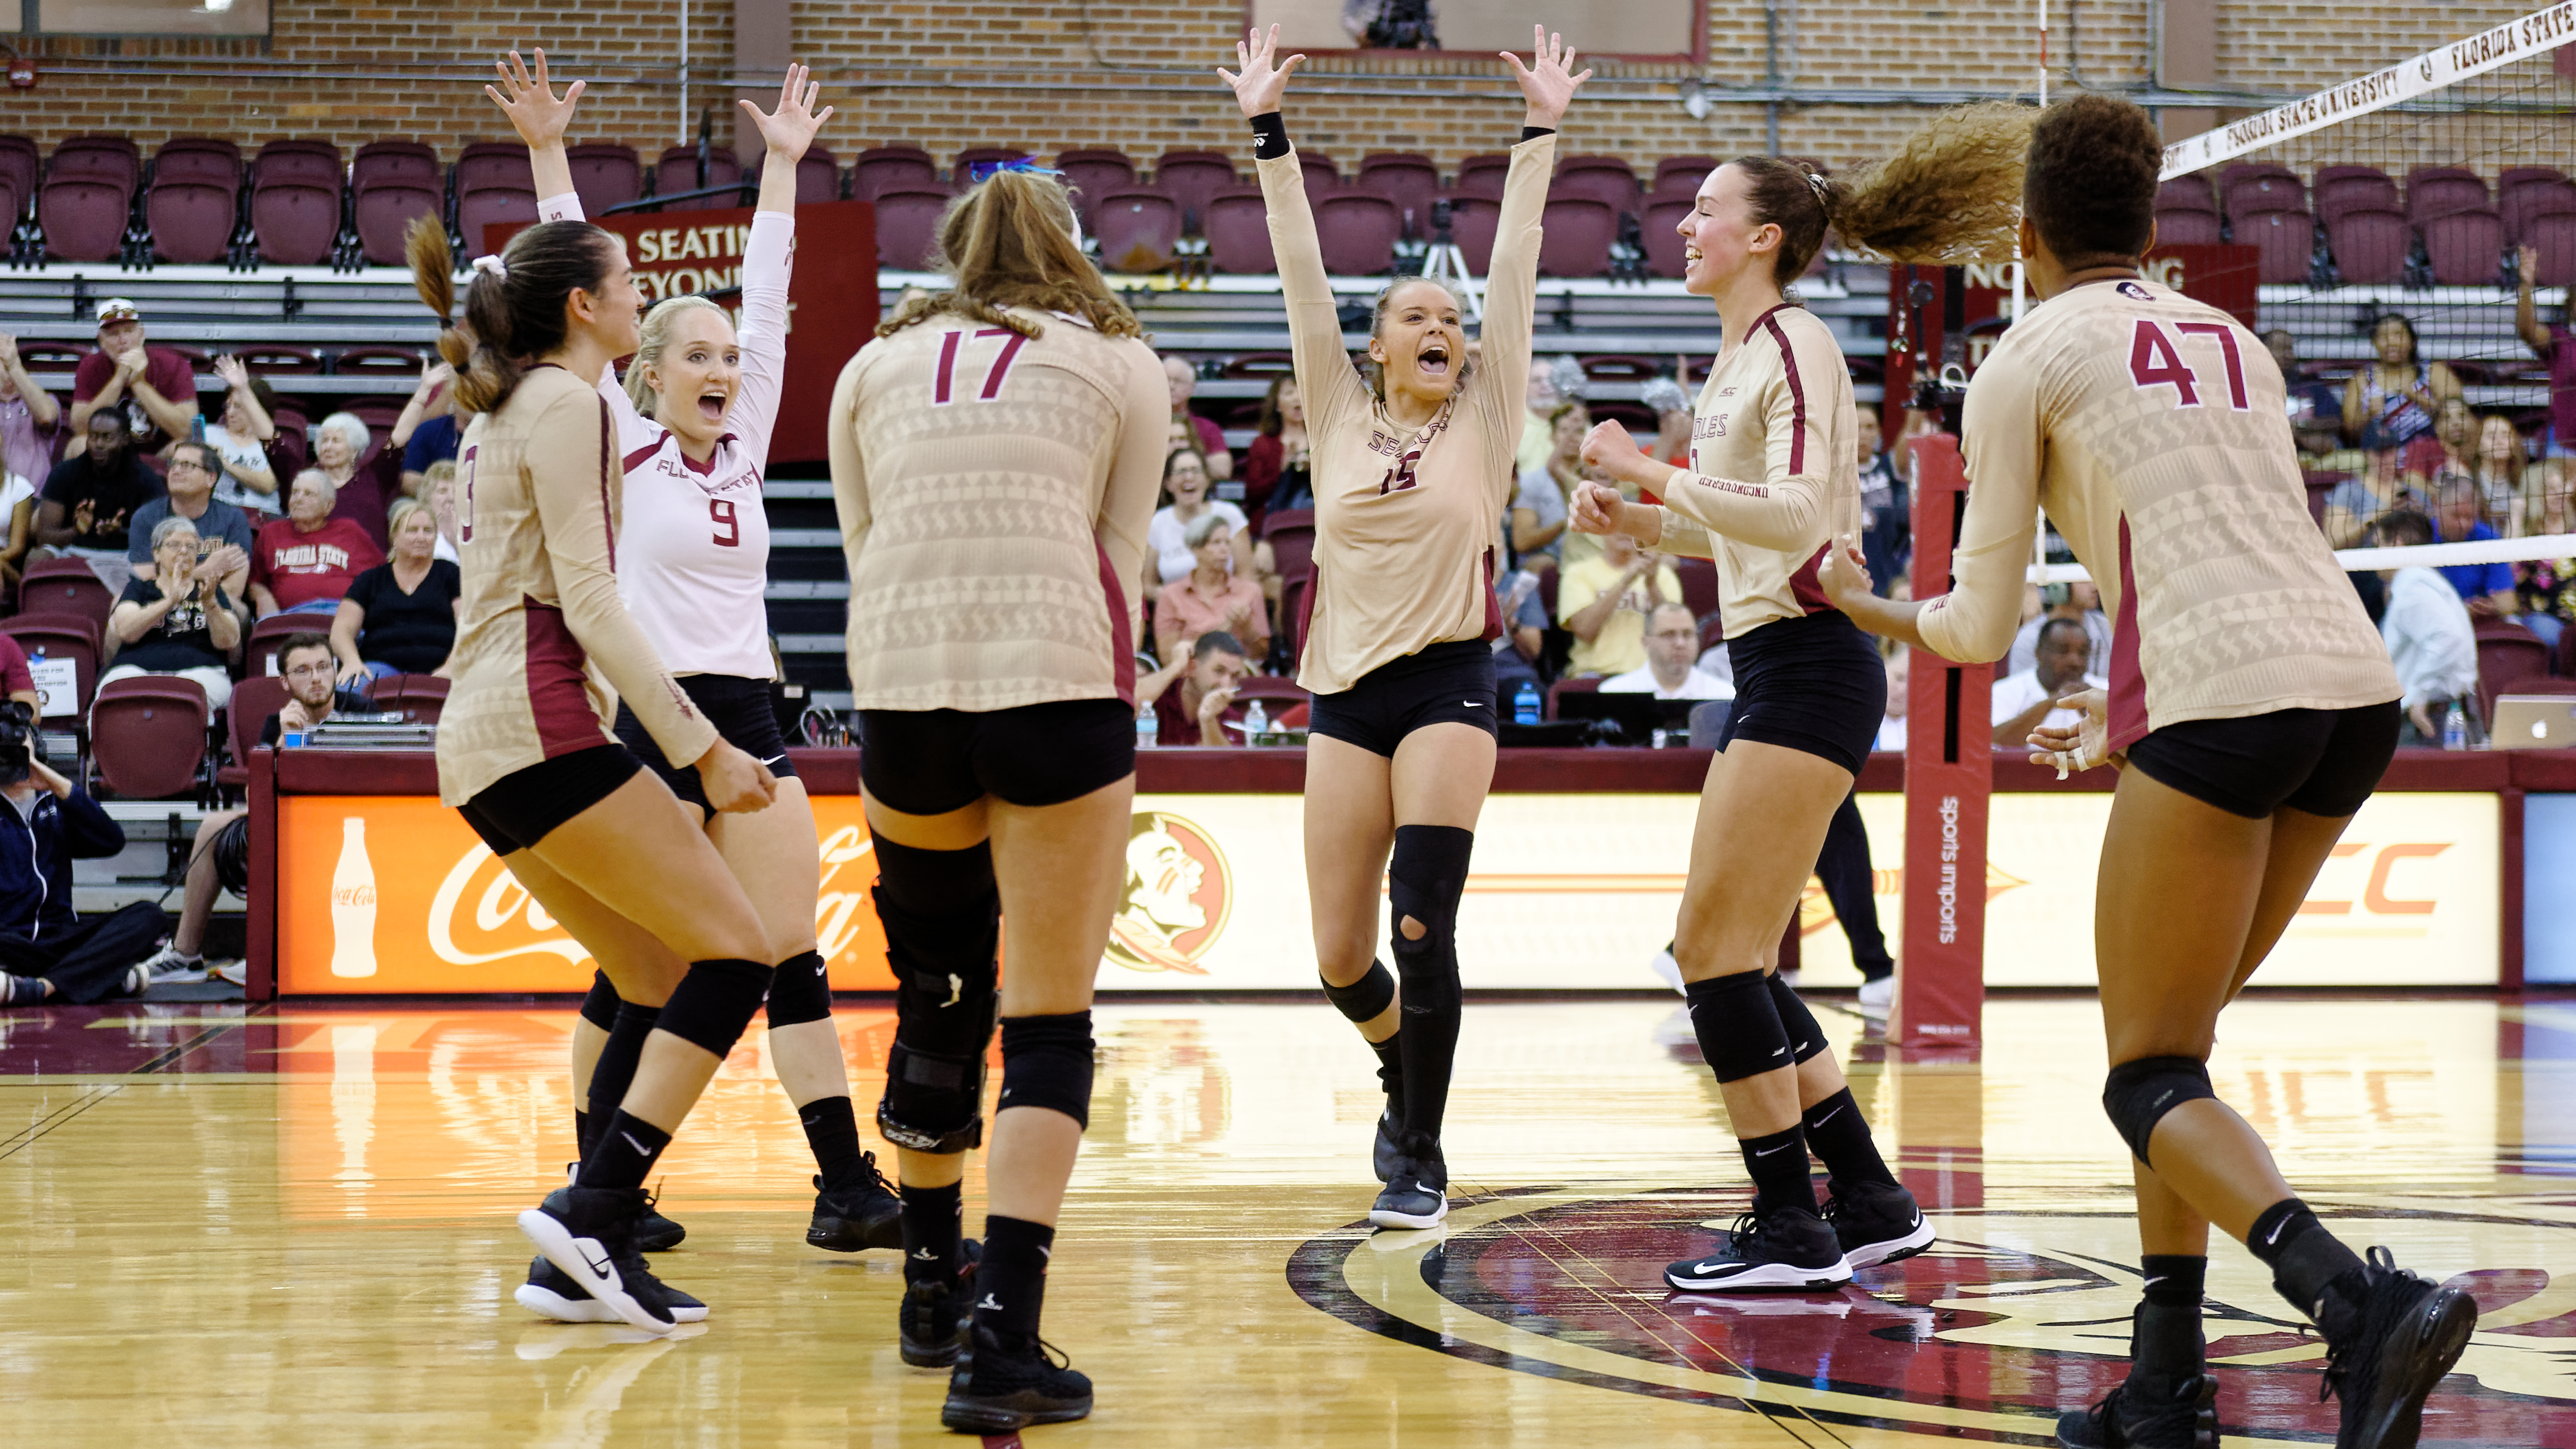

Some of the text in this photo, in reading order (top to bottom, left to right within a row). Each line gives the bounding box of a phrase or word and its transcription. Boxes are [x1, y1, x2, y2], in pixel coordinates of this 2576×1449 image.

[2451, 4, 2574, 71] FLORIDA STATE
[2278, 99, 2316, 132] STATE
[931, 327, 1029, 407] 17
[2126, 319, 2252, 413] 47
[1698, 477, 1768, 499] UNCONQUERED
[709, 497, 739, 547] 9
[274, 543, 349, 571] FLORIDA STATE
[1937, 796, 1959, 944] sports imports
